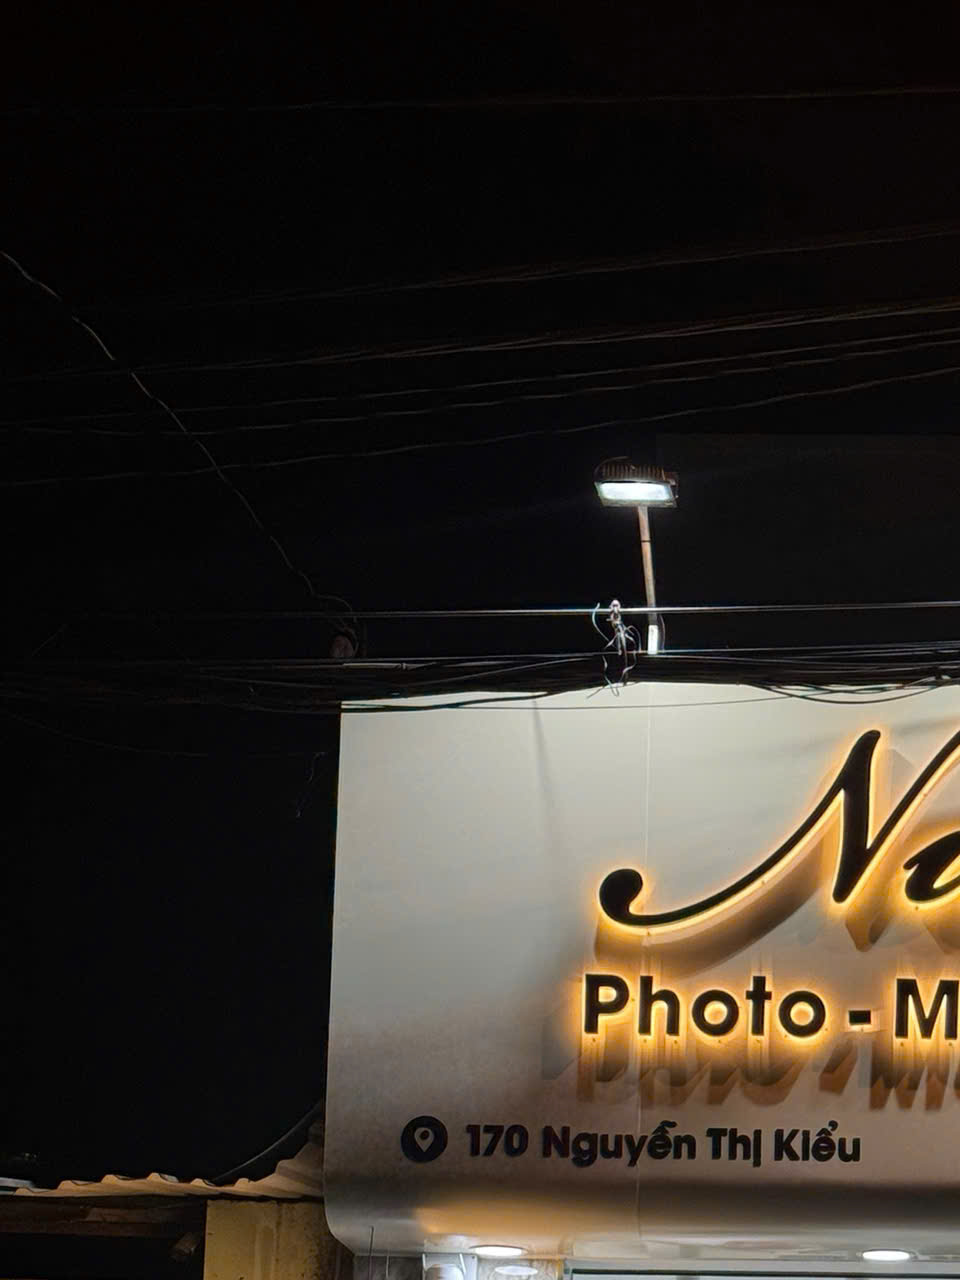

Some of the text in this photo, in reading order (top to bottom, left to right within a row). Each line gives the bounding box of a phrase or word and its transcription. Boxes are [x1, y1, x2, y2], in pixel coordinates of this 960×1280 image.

[583, 973, 827, 1038] Photo
[465, 1119, 862, 1168] 170 Nguyễn Thị Kiểu
